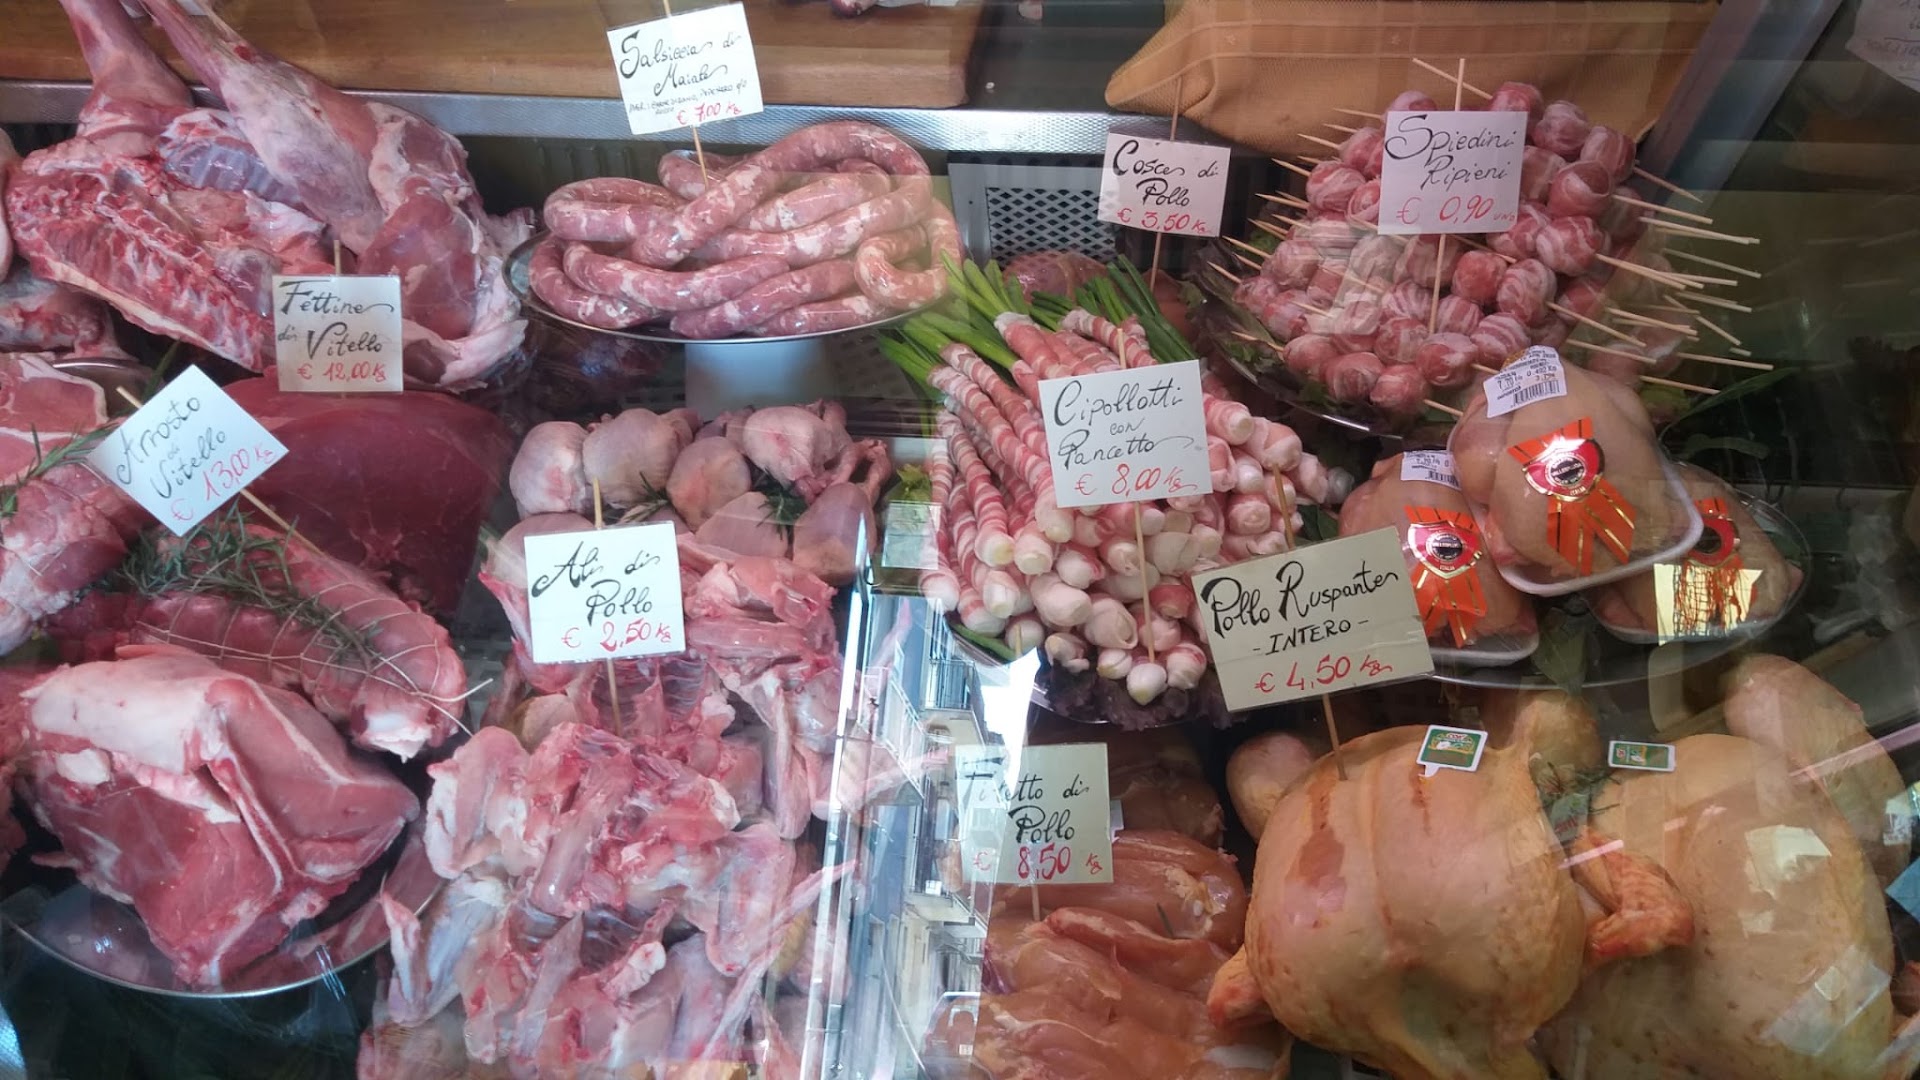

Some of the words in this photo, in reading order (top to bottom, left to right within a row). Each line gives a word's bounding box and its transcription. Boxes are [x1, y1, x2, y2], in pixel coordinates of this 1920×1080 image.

[620, 30, 713, 79] Salsiccia
[723, 32, 742, 48] di
[653, 63, 728, 96] Maiale
[677, 110, 688, 125] €
[1112, 139, 1185, 176] Cosce
[1197, 160, 1219, 178] di
[1384, 114, 1517, 168] Spiedini
[1136, 177, 1190, 207] Pollo
[1420, 154, 1511, 192] Ripieni
[1117, 207, 1132, 223] €
[1396, 197, 1423, 225] €
[1439, 194, 1495, 225] 0,90
[279, 280, 394, 315] Fettine
[277, 323, 297, 342] di
[307, 321, 383, 360] Vitello
[297, 363, 313, 380] €
[1054, 377, 1183, 426] Cipollotti
[116, 397, 200, 485] Arrosto
[1110, 417, 1145, 436] con
[150, 427, 226, 499] Vitello
[1074, 473, 1098, 496] €
[1111, 463, 1162, 497] 8,00
[170, 498, 194, 521] €
[202, 448, 250, 501] 13,00
[531, 541, 604, 598] Ali
[624, 549, 661, 575] di
[585, 579, 653, 627] Pollo
[1200, 576, 1270, 639] Pollo
[1275, 560, 1399, 621] Ruspante
[561, 626, 581, 648] €
[600, 617, 652, 652] 2,50
[1254, 672, 1275, 693] €
[1062, 774, 1090, 798] di
[1008, 804, 1075, 844] Pollo
[973, 851, 991, 871] €
[1018, 842, 1071, 880] 8,50
